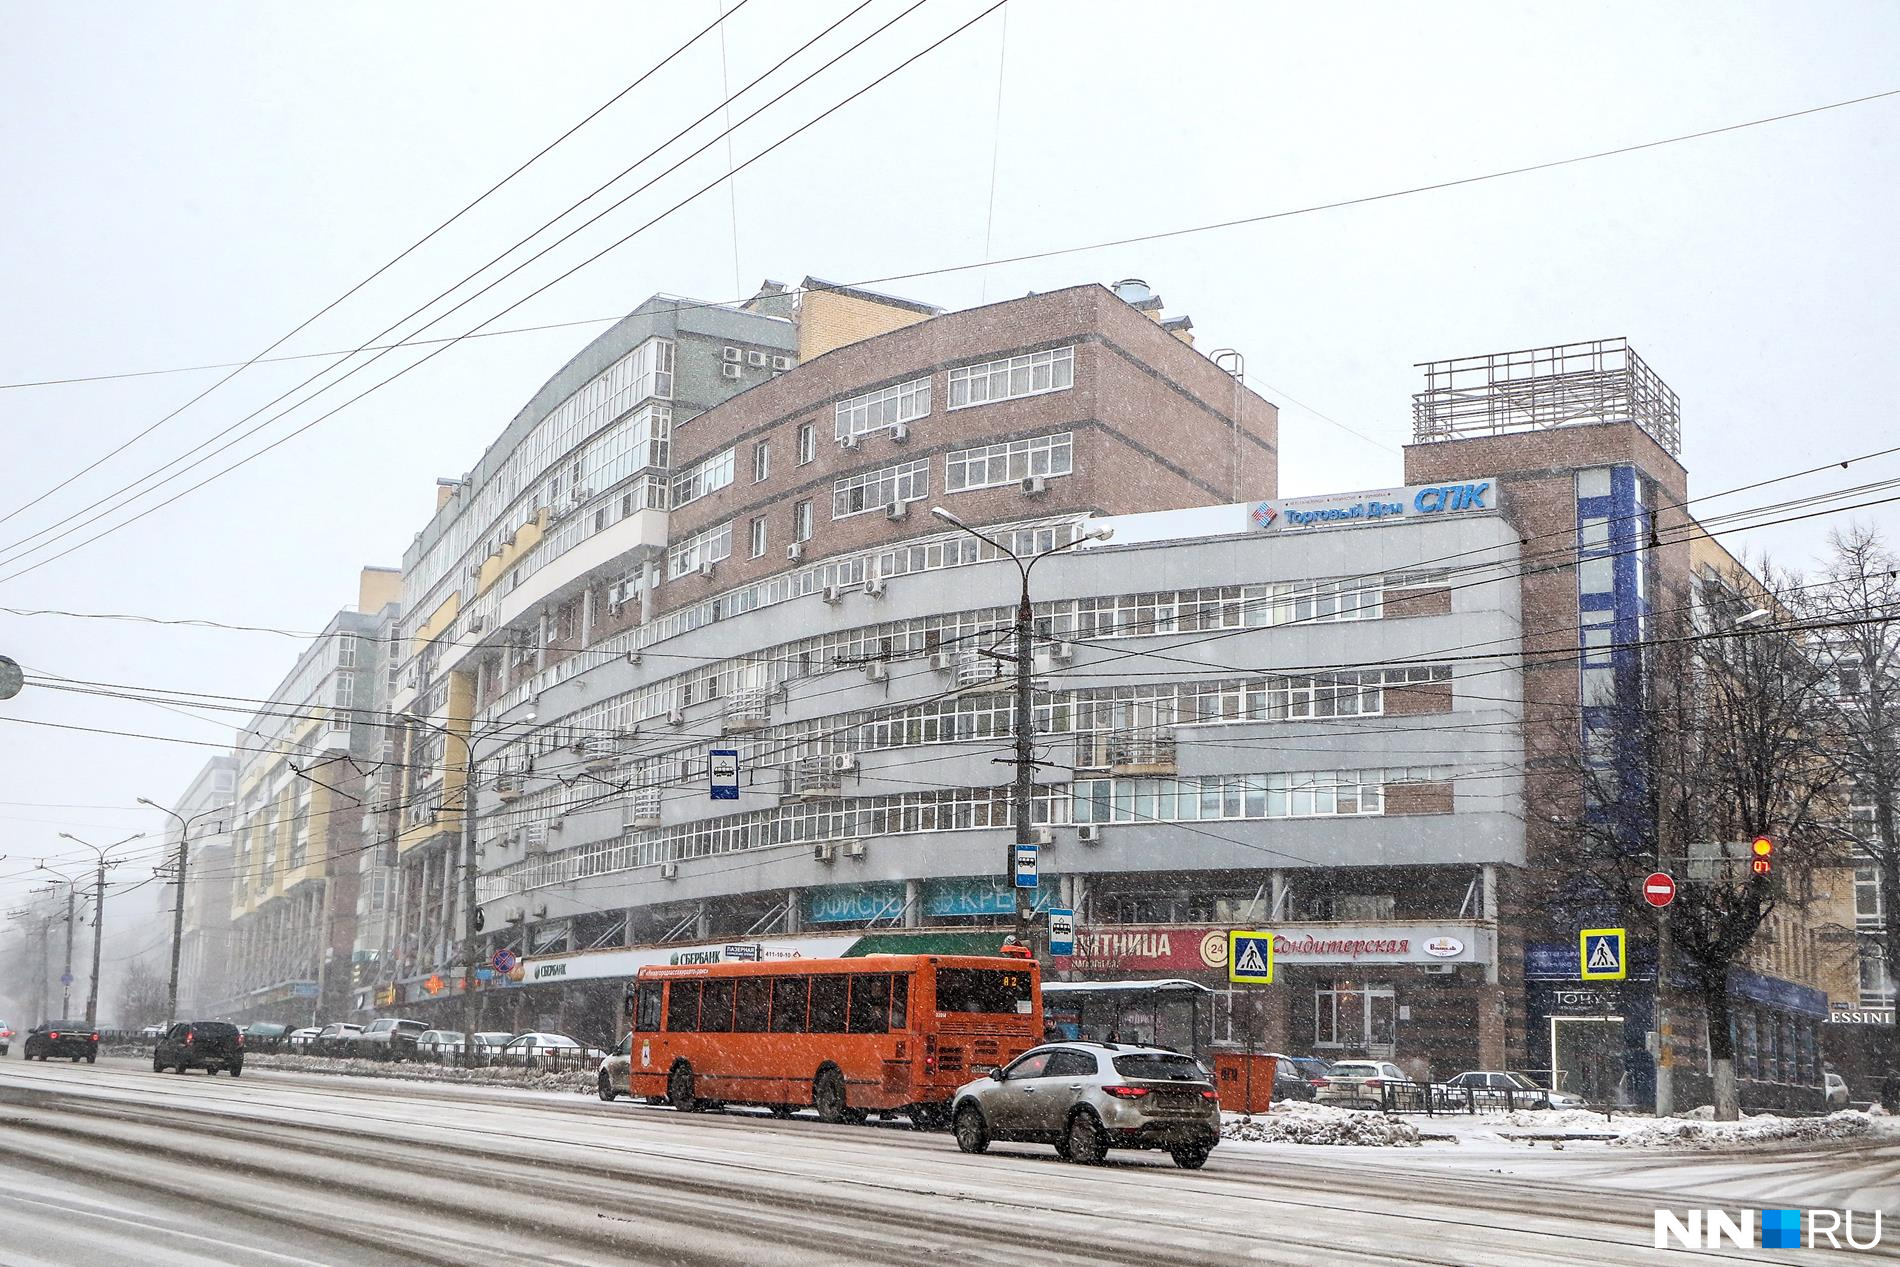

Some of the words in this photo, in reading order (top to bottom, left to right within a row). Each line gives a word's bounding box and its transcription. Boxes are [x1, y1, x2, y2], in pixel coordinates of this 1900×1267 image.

[1414, 482, 1490, 513] СПК
[1284, 503, 1364, 525] Торговый
[1367, 501, 1403, 519] Дом
[1753, 860, 1769, 873] 07
[1210, 944, 1224, 954] 24
[680, 950, 721, 965] СБЕРБАНК
[540, 963, 567, 977] СБЕРБАНК
[1822, 1011, 1890, 1024] ESSINI
